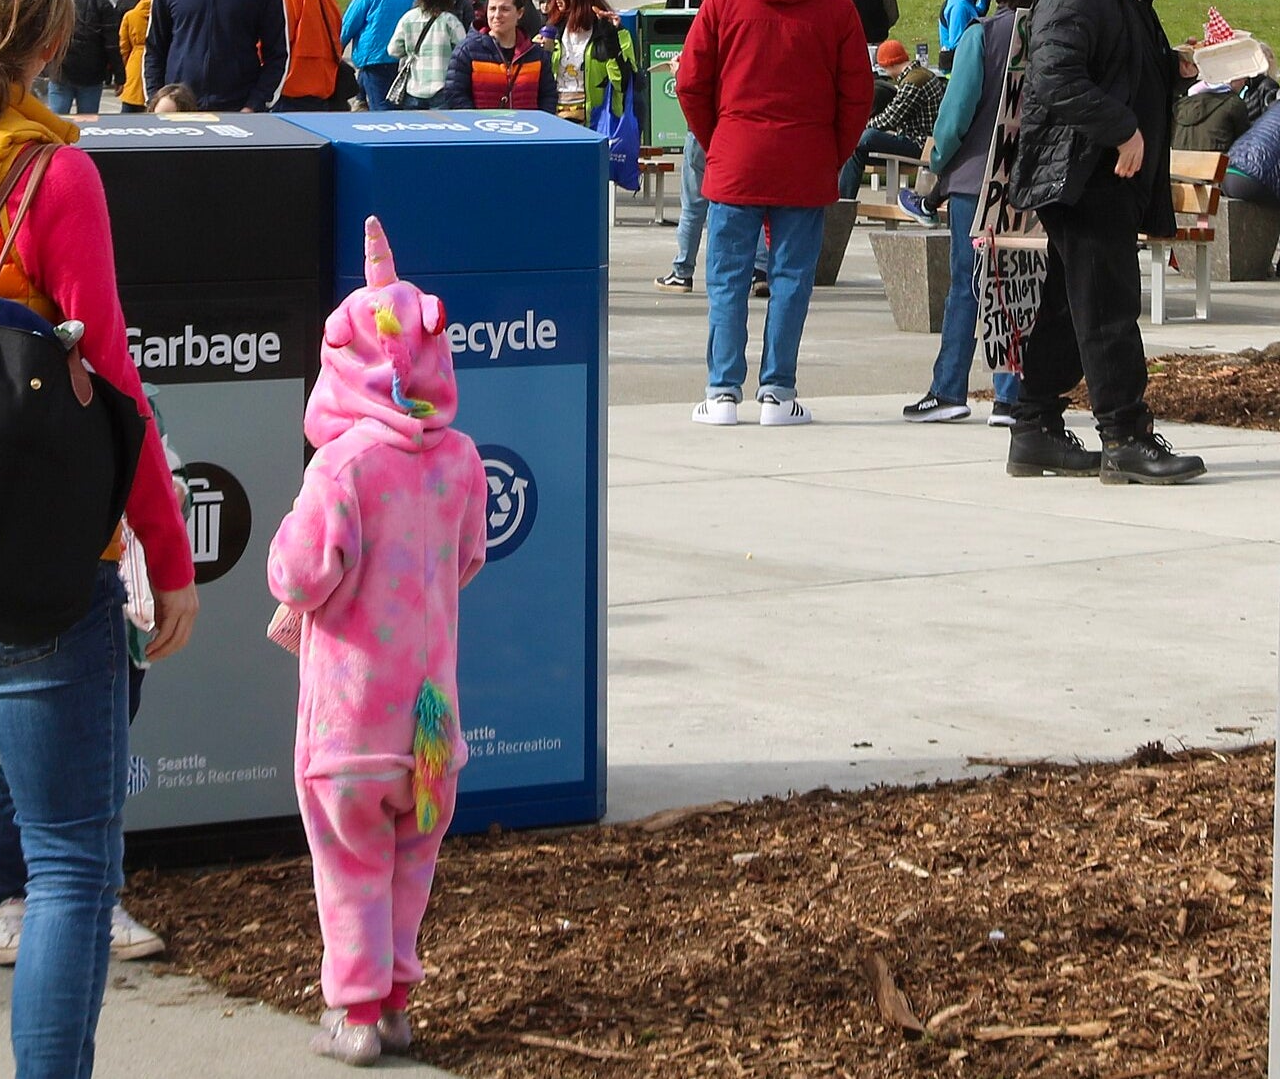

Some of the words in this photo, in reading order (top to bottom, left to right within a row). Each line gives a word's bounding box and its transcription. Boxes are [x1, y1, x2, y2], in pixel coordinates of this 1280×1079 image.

[654, 48, 684, 62] Comp
[352, 122, 471, 133] Recycle
[446, 309, 557, 360] ecycle
[124, 324, 281, 373] Garbage
[918, 398, 939, 411] HOKA
[497, 737, 561, 755] Recreation
[157, 754, 207, 772] Seattle
[157, 773, 193, 790] Parks
[195, 771, 206, 785] &
[208, 765, 278, 784] Recreation
